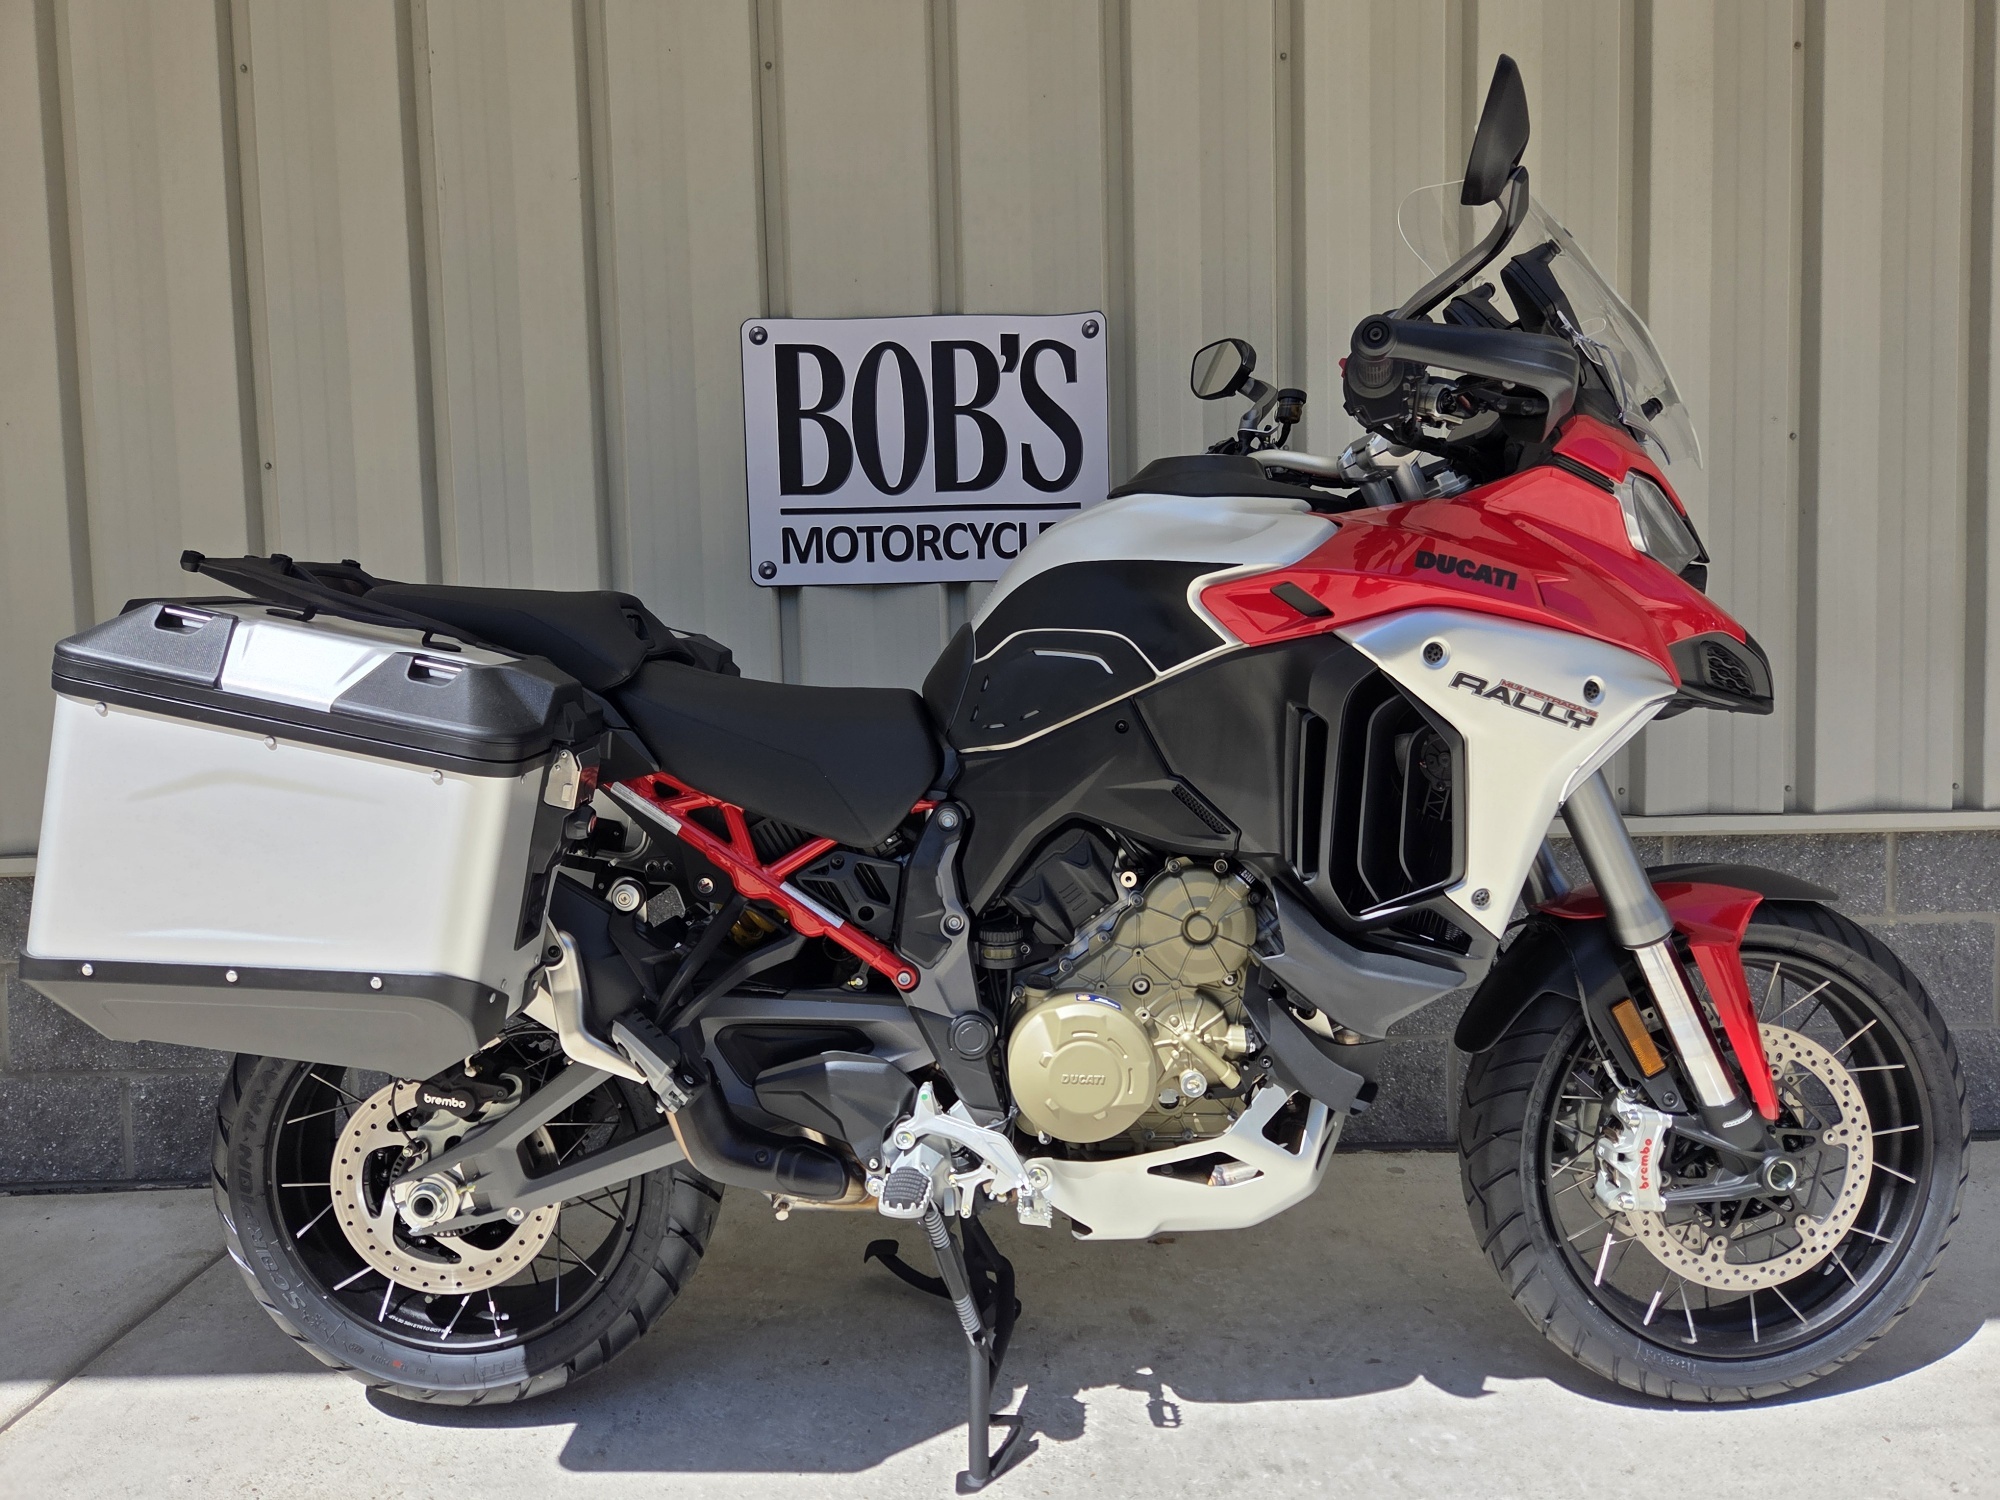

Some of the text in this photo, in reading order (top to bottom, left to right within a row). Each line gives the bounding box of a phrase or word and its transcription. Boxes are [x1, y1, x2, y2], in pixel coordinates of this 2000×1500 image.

[774, 333, 1084, 496] BOB'S
[782, 521, 1058, 565] MOTORCYCL
[1414, 550, 1518, 591] DUCATI
[1449, 671, 1597, 730] RALLY
[423, 1092, 467, 1109] brembo
[1061, 1073, 1106, 1086] DUCATI
[1639, 1138, 1653, 1190] brembo
